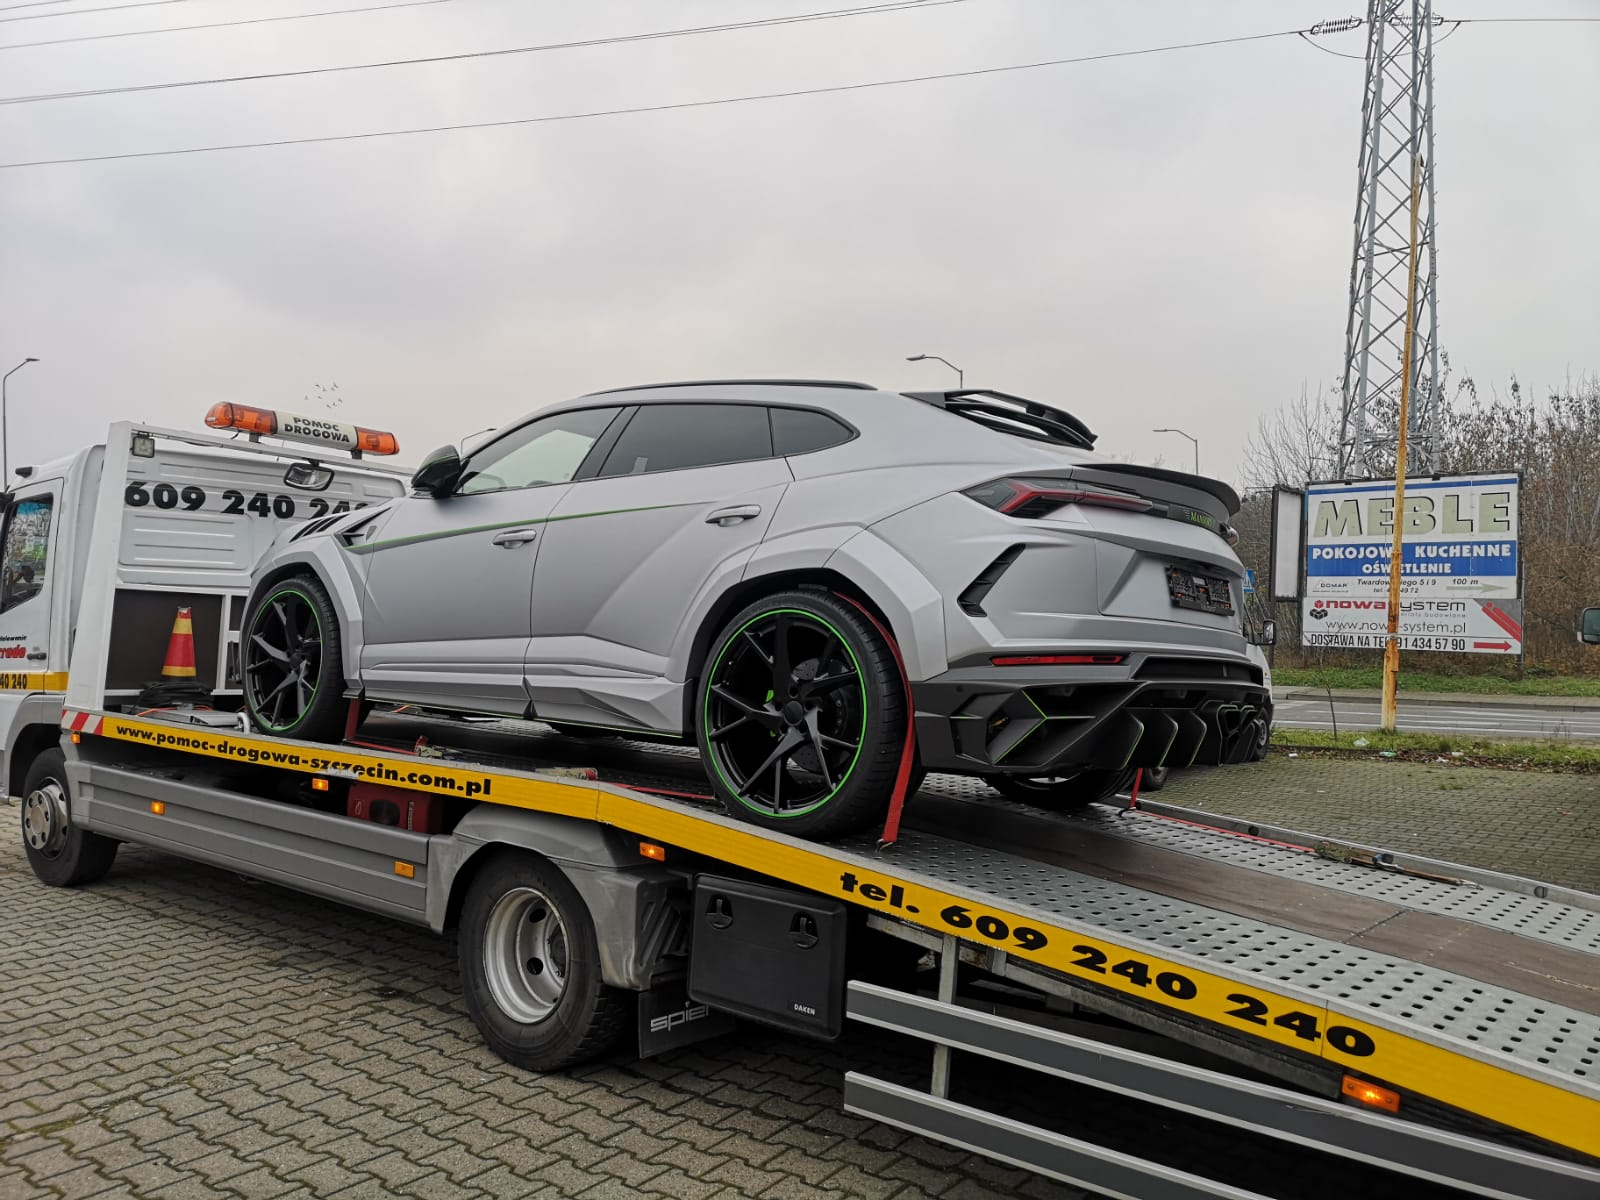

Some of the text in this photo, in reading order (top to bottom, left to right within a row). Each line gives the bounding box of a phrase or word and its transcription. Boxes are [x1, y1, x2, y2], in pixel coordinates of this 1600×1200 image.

[293, 416, 339, 431] POMOC
[284, 423, 350, 442] DROGOWA
[124, 480, 369, 520] 609 240 24
[1312, 492, 1511, 537] MEBLE
[1312, 544, 1511, 560] POKOJOW KUCHENNE
[1362, 561, 1452, 574] OŚWTLENIE
[1357, 578, 1418, 587] Twardowiego
[1326, 620, 1466, 634] www.now-system.pl
[1311, 633, 1356, 646] DOSTAWA
[1357, 635, 1370, 647] NA
[1411, 637, 1432, 649] 434
[1435, 638, 1448, 650] 57
[1451, 638, 1465, 650] 90
[116, 725, 492, 797] www.pomoc-drogowa-szczecin.com.pl
[840, 872, 1376, 1057] tel. 609 240 240
